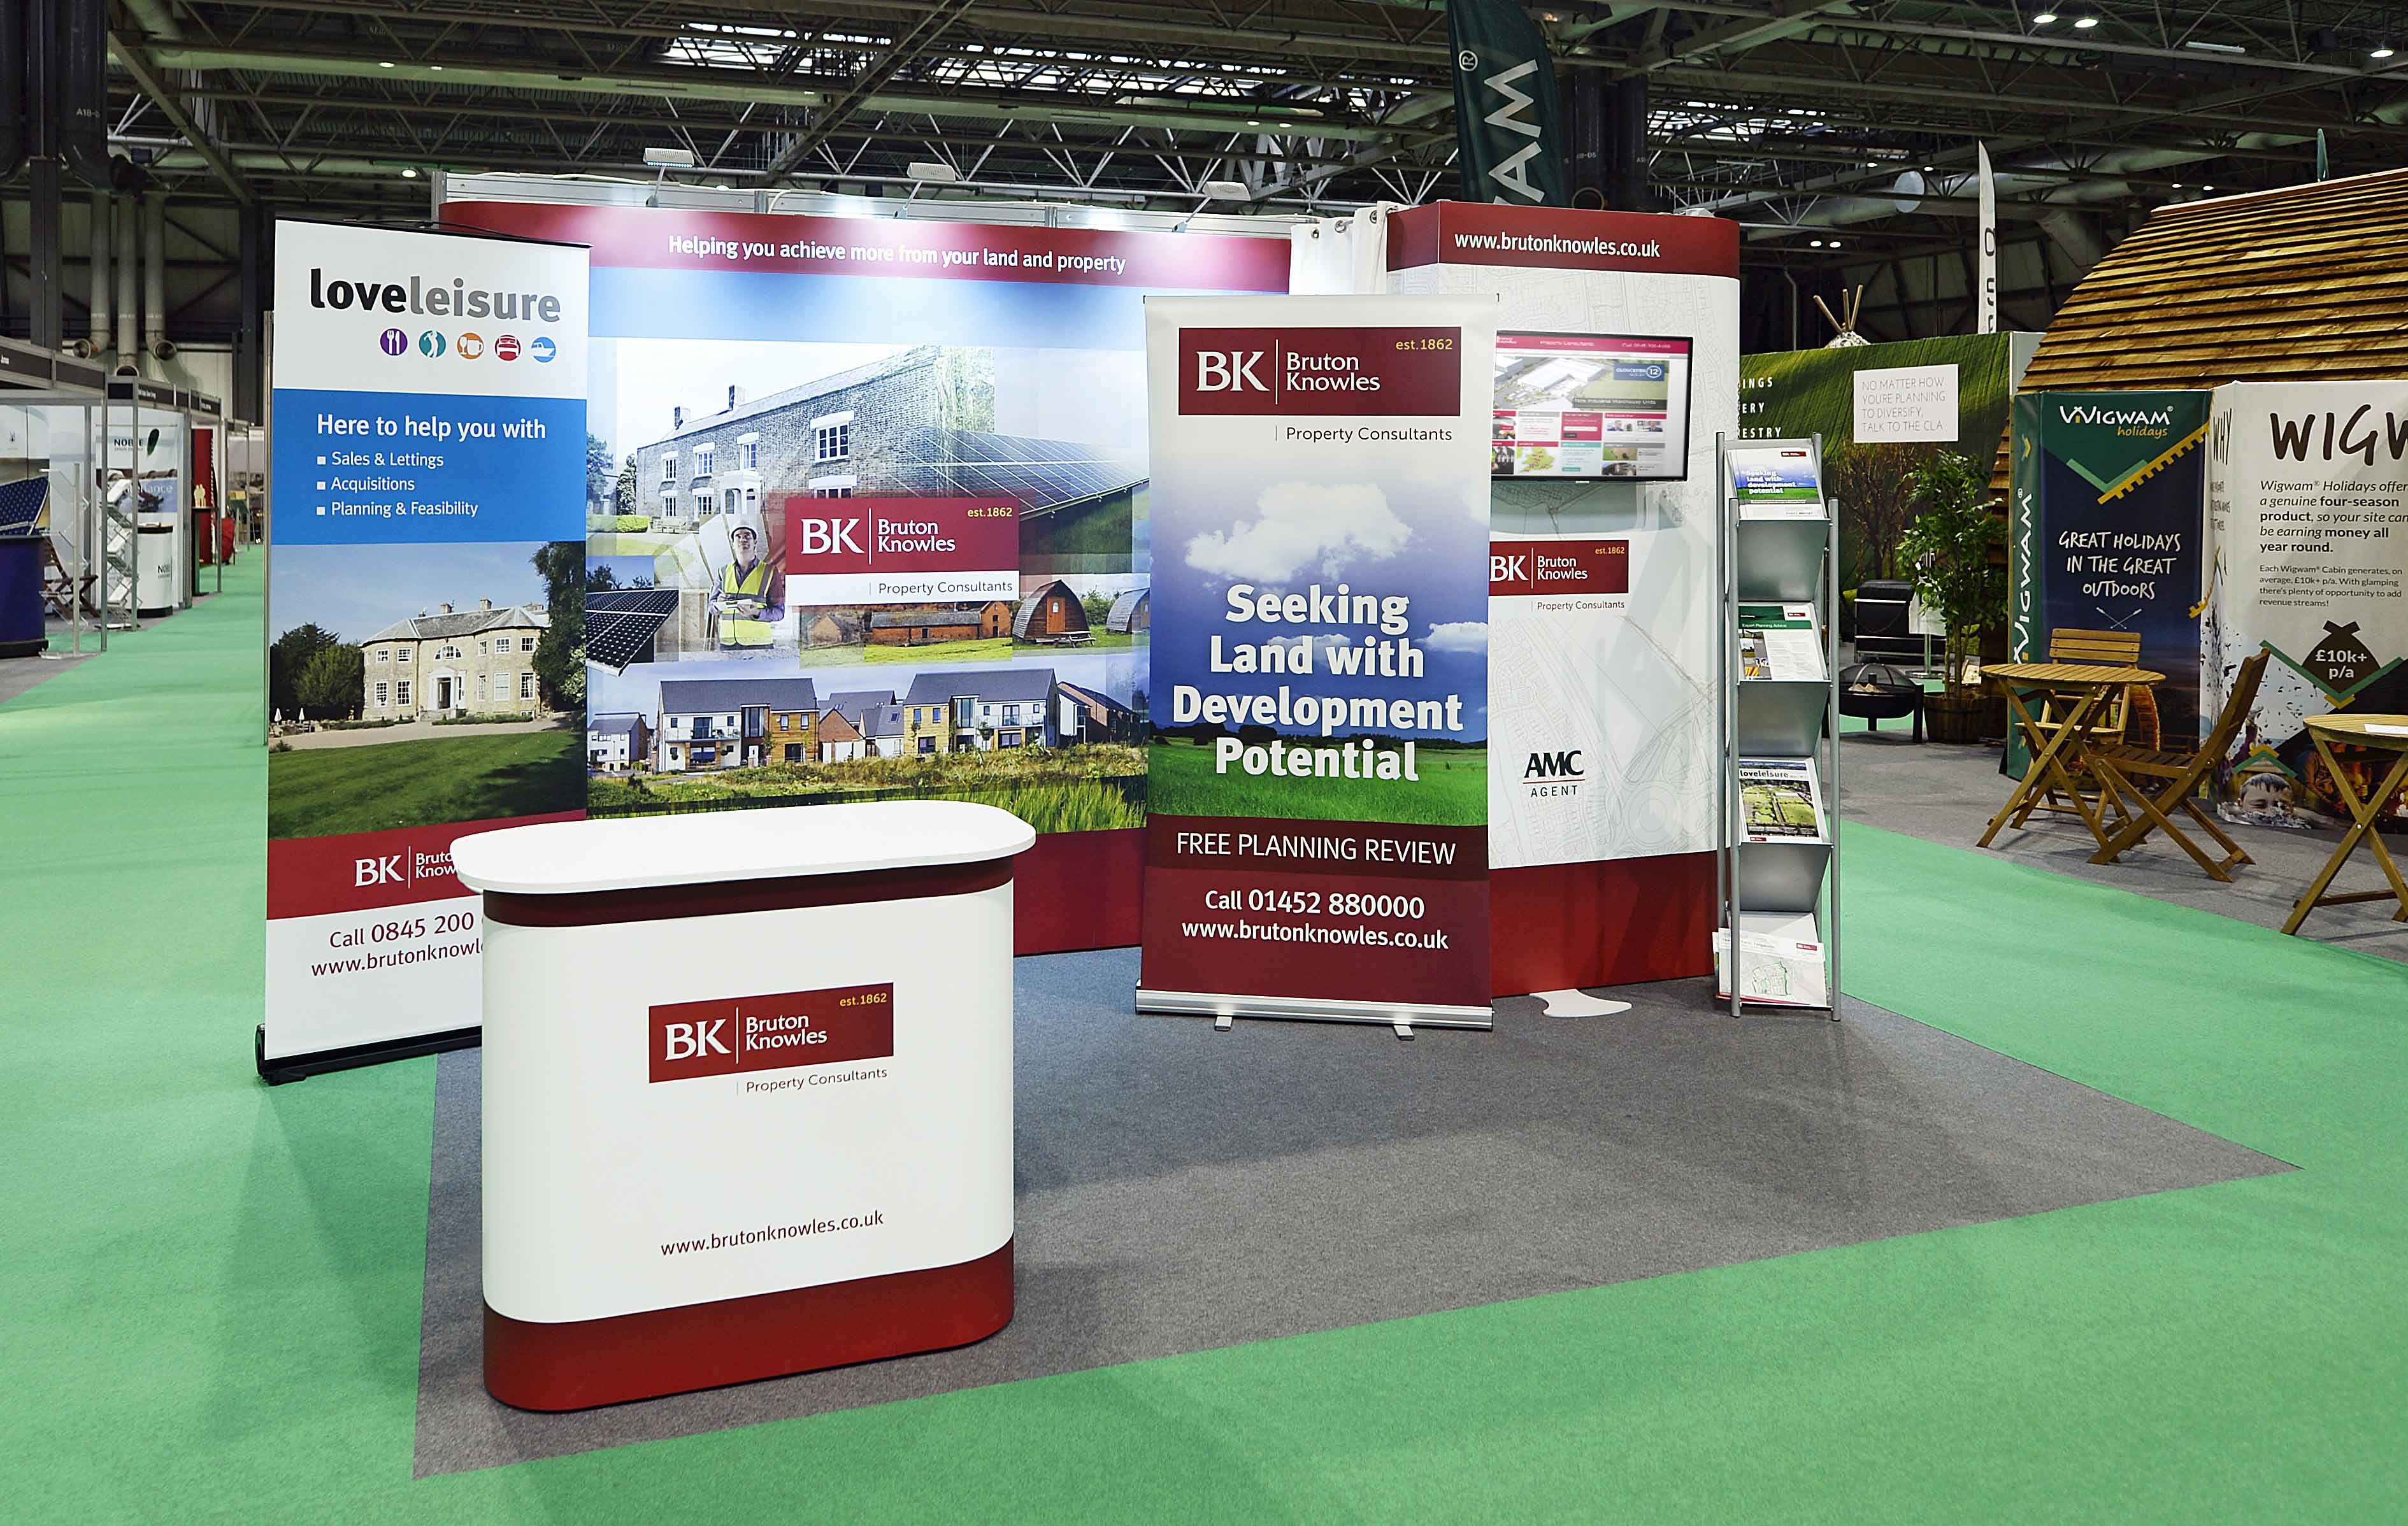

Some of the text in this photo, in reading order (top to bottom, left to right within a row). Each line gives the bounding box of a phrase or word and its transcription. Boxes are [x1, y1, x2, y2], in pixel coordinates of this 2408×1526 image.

[1454, 231, 1660, 257] www.brutonknowles.co.uk
[668, 235, 1126, 275] Helping you achieve more from your land and property
[310, 268, 561, 322] loveleisure
[1395, 339, 1453, 351] est.1862
[1286, 352, 1359, 371] Bruton
[1196, 351, 1270, 392] BK
[1286, 372, 1380, 391] Knowles
[1742, 376, 1773, 389] INGS
[1862, 376, 1944, 390] NO MATTER HOW
[1895, 391, 1946, 403] PLANNING
[1742, 403, 1765, 413] ERY
[1862, 408, 1875, 418] TO
[317, 414, 547, 445] Here to help you with
[1742, 427, 1781, 438] ESTRY
[1862, 420, 1943, 432] TALK TO THE CLA
[2117, 426, 2168, 439] holidays
[1286, 427, 1452, 444] Property Consultants
[331, 452, 444, 470] Sales & Lettings
[331, 476, 415, 494] Acquisitions
[2323, 480, 2376, 493] Holidays
[331, 501, 479, 519] Planning & Feasibility
[2269, 497, 2317, 508] genuine
[2319, 496, 2399, 507] four-season
[968, 508, 1013, 518] est.1862
[2260, 511, 2314, 524] product,
[2333, 514, 2361, 525] your
[2363, 512, 2385, 522] site
[801, 518, 865, 554] BK
[878, 519, 938, 536] Bruton
[2260, 526, 2389, 539] be earning money all
[878, 534, 956, 553] Knowles
[2059, 531, 2181, 552] GREAT HOLIDAYS
[2260, 542, 2333, 553] year round.
[1490, 555, 1529, 581] BK
[1537, 555, 1577, 567] Bruton
[2067, 556, 2177, 575] IN THE GREAT
[1537, 567, 1587, 580] Knowles
[2347, 567, 2391, 576] generates,
[879, 581, 1013, 595] Property Consultants
[2082, 581, 2156, 600] OUTDOORS
[2361, 578, 2399, 587] glamping
[2288, 588, 2314, 597] plenty
[2325, 589, 2375, 598] opportunity
[1225, 583, 1410, 636] Seeking
[1537, 601, 1625, 611] Property Consultants
[1210, 635, 1424, 678] Land with
[2315, 650, 2368, 663] £10k+
[2329, 666, 2354, 680] p/a
[1173, 685, 1464, 737] Development
[1215, 737, 1419, 781] Potential
[1524, 750, 1584, 778] AMC
[1531, 785, 1577, 797] AGENT
[1177, 832, 1456, 865] FREE PLANNING REVIEW
[416, 853, 452, 866] Bruto
[354, 855, 405, 887] BK
[415, 865, 457, 879] Know
[1205, 889, 1424, 919] Call 01452 880000
[330, 928, 364, 948] Call
[371, 918, 426, 943] 0845
[434, 912, 474, 934] 200
[1182, 920, 1449, 950] www.brutonknowles.co.uk
[840, 993, 887, 1007] est.1862
[745, 1015, 810, 1034] Bruton
[664, 1018, 731, 1060] BK
[745, 1029, 828, 1051] Knowles
[746, 1067, 887, 1094] Property Consultants
[661, 1209, 884, 1256] www.brutonknowles.co.uk
